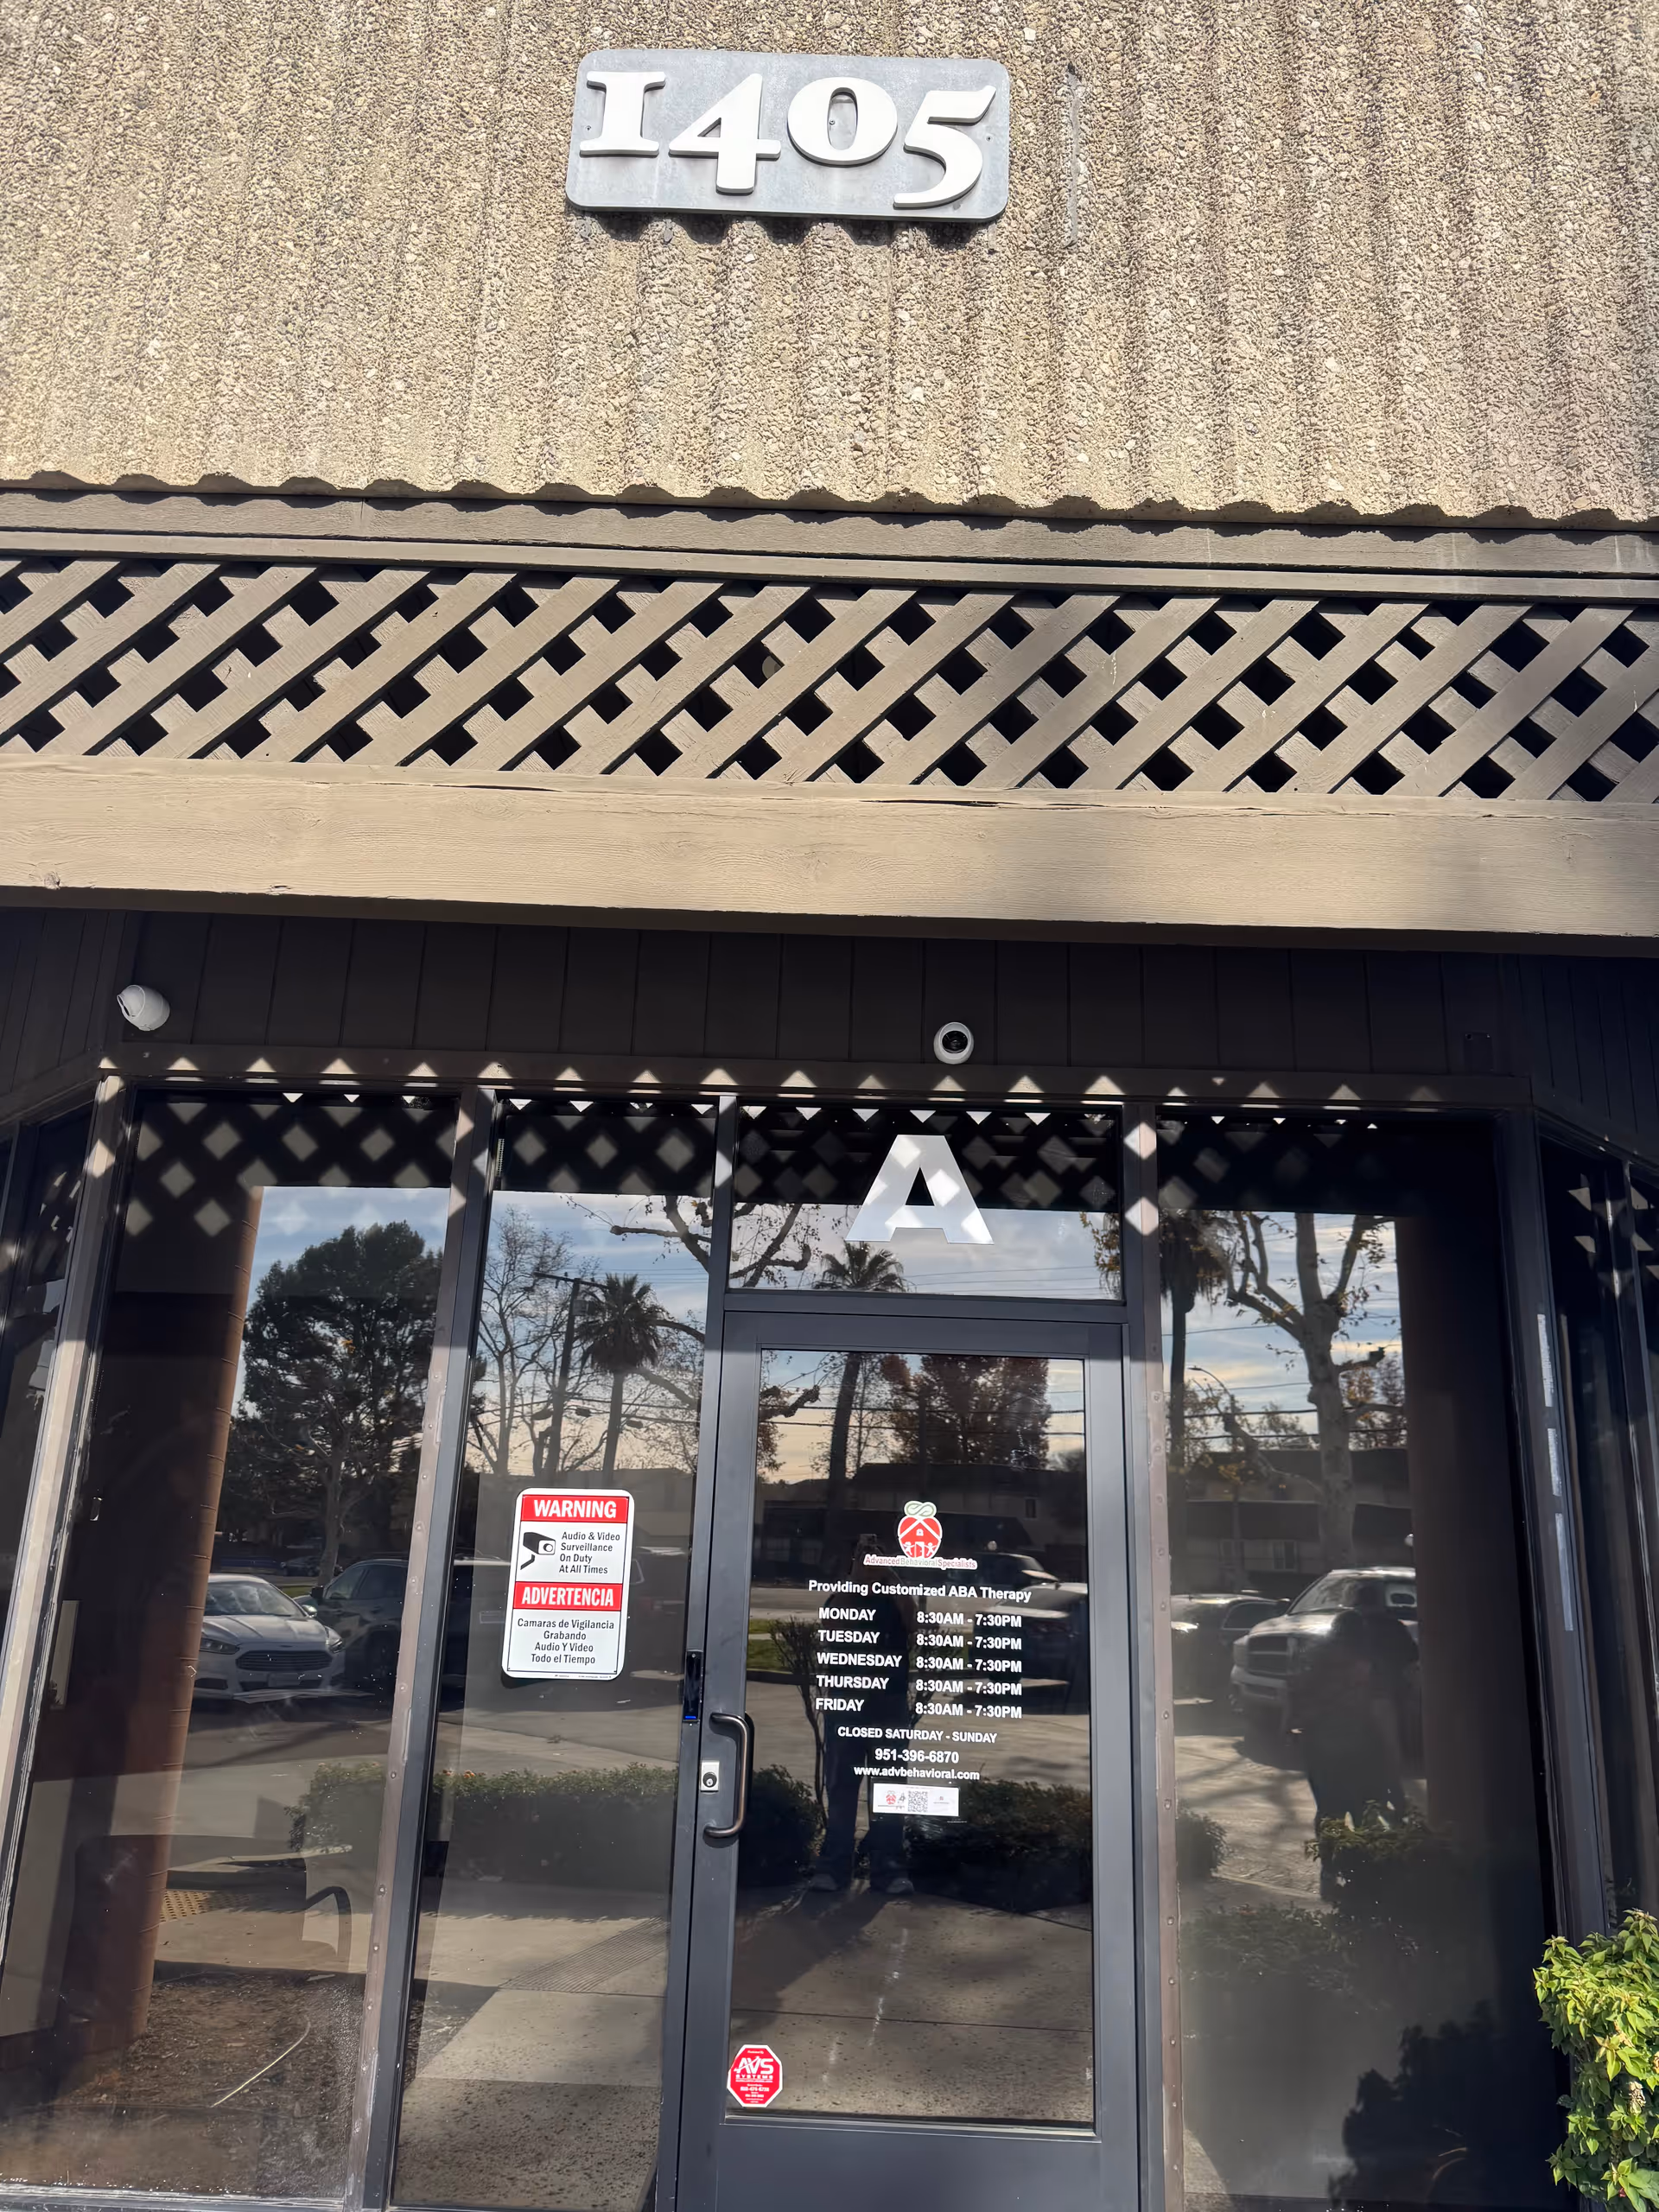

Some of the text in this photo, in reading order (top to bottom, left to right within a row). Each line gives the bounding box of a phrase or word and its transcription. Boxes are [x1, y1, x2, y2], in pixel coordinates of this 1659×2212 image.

[579, 70, 996, 210] 1405
[844, 1135, 995, 1245] A
[533, 1499, 617, 1519] WARNING
[562, 1531, 620, 1541] Audio & Video
[561, 1542, 613, 1552] Surveillance
[560, 1554, 593, 1565] On Duty
[559, 1565, 608, 1574] At All Times
[521, 1586, 614, 1606] ADVERTENCIA
[808, 1580, 1032, 1603] Providing Customized ABA Therapy
[518, 1618, 614, 1630] Camaras de Vigilancia
[818, 1607, 876, 1621] MONDAY
[916, 1611, 963, 1625] 8:30AM
[975, 1613, 1021, 1628] 7:30PM
[543, 1630, 587, 1640] Grabando
[817, 1630, 880, 1643] TUESDAY
[916, 1633, 963, 1648] 8:30AM
[975, 1636, 1021, 1650] 7:30PM
[534, 1642, 594, 1652] Audio Y Video
[531, 1654, 595, 1666] Todo el Tiempo
[817, 1652, 902, 1668] WEDNESDAY
[916, 1656, 963, 1671] 8:30AM
[975, 1659, 1021, 1674] 7:30PM
[817, 1675, 889, 1689] THURSDAY
[916, 1679, 963, 1694] 8:30AM
[975, 1681, 1021, 1696] 7:30PM
[816, 1698, 864, 1712] FRIDAY
[916, 1702, 963, 1717] 8:30AM
[975, 1705, 1021, 1719] 7:30PM
[837, 1726, 882, 1738] CLOSED
[885, 1728, 944, 1741] SATURDAY
[952, 1731, 997, 1744] SUNDAY
[874, 1748, 959, 1764] 951-396-6870
[854, 1765, 980, 1781] www.advbehavioral.com
[733, 2056, 774, 2075] AVS
